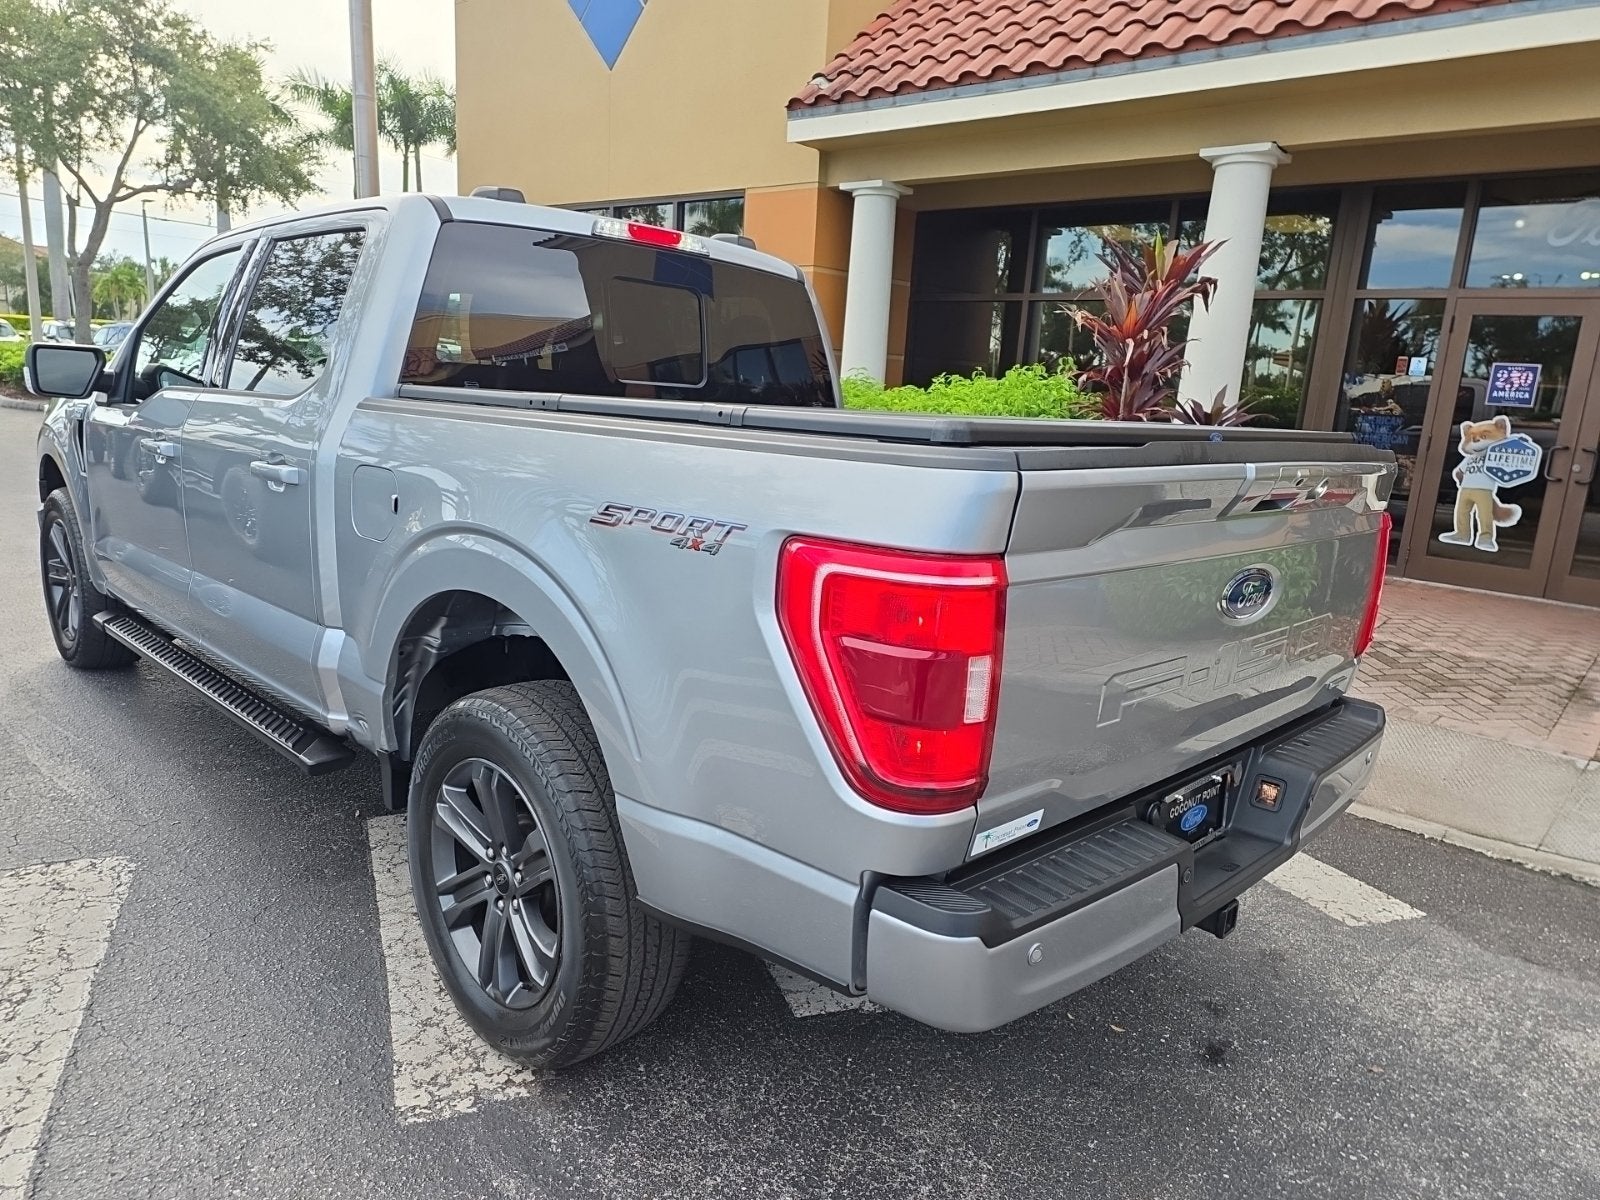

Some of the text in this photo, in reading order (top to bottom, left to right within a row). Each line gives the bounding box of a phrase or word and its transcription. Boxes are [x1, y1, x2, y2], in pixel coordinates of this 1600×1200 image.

[1492, 390, 1530, 399] AMERICA
[1487, 453, 1535, 466] LIFETIME
[589, 501, 748, 544] SPORT
[1095, 612, 1334, 728] F-150
[1169, 784, 1221, 819] COCONUT POINT
